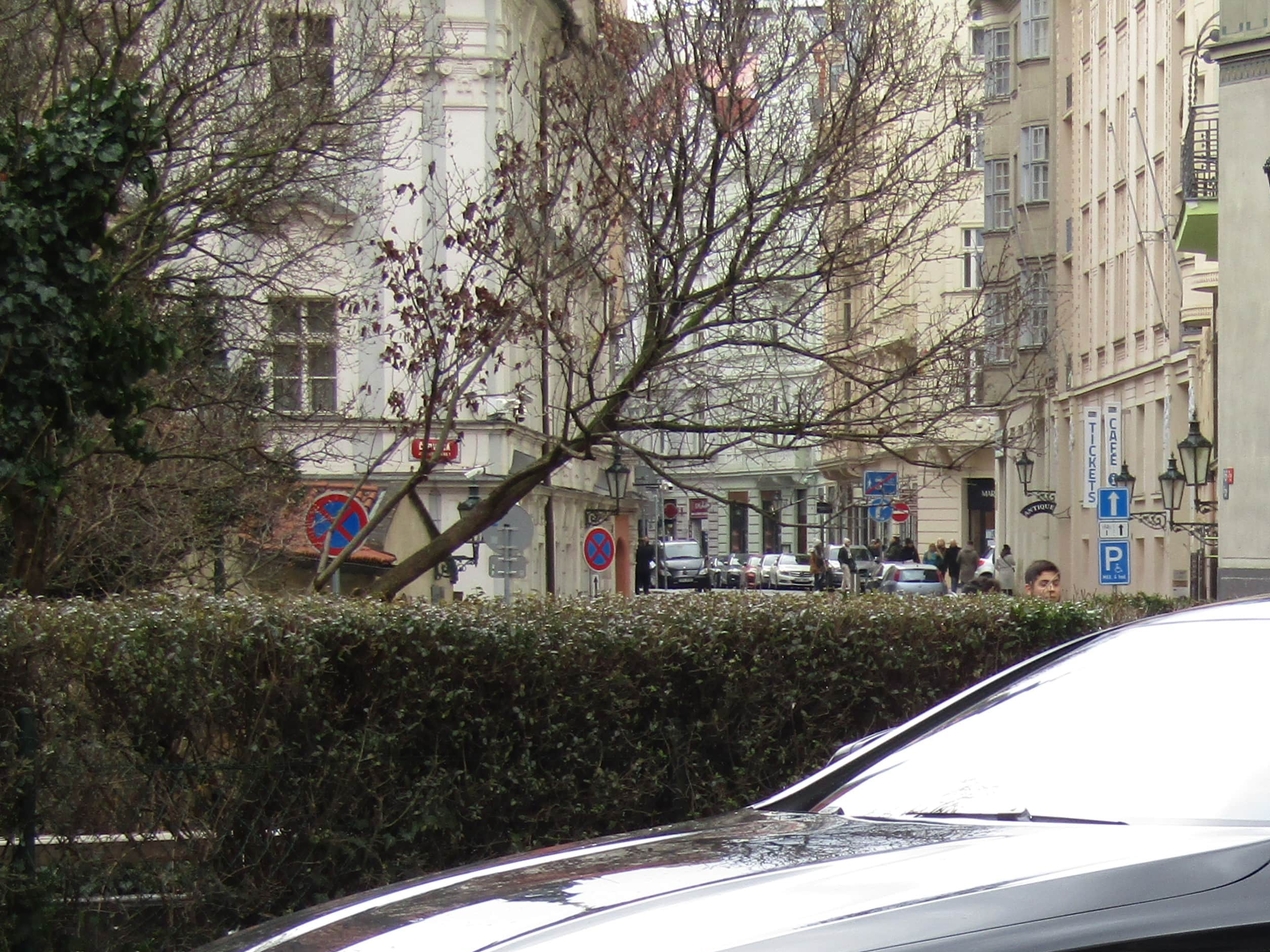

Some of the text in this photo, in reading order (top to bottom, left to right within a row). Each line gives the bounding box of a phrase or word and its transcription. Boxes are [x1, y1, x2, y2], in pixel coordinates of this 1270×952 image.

[1087, 422, 1097, 503] TICKETS
[1024, 503, 1054, 516] ANTIQUE
[1105, 546, 1123, 571] P
